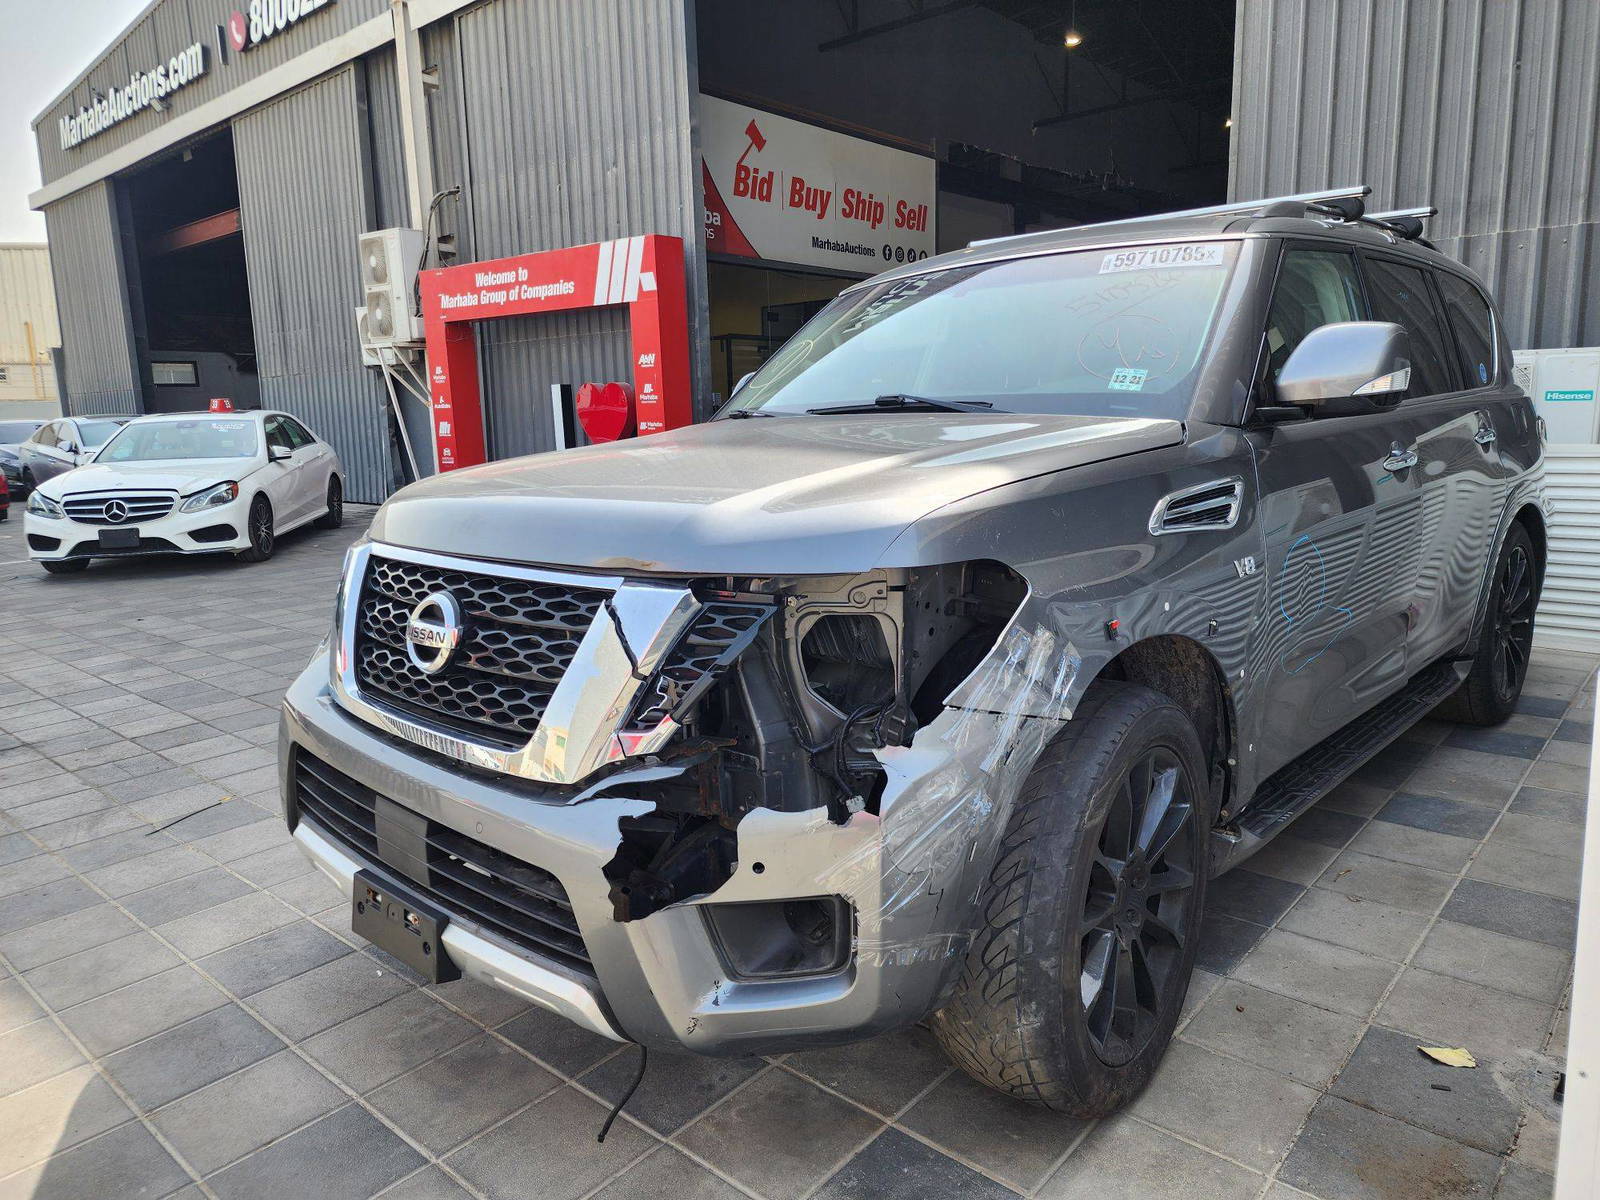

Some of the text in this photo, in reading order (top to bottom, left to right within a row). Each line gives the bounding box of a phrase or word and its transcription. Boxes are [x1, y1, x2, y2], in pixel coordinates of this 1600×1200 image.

[59, 42, 203, 150] MarhabaAuctions.com
[733, 163, 928, 232] Bid Buy Ship Sell
[811, 236, 876, 257] MarhabaAuctions
[475, 266, 528, 288] Welcome to
[441, 279, 575, 309] Marhaba Group of Companies
[1546, 392, 1592, 400] Hisense
[1233, 556, 1256, 578] V8
